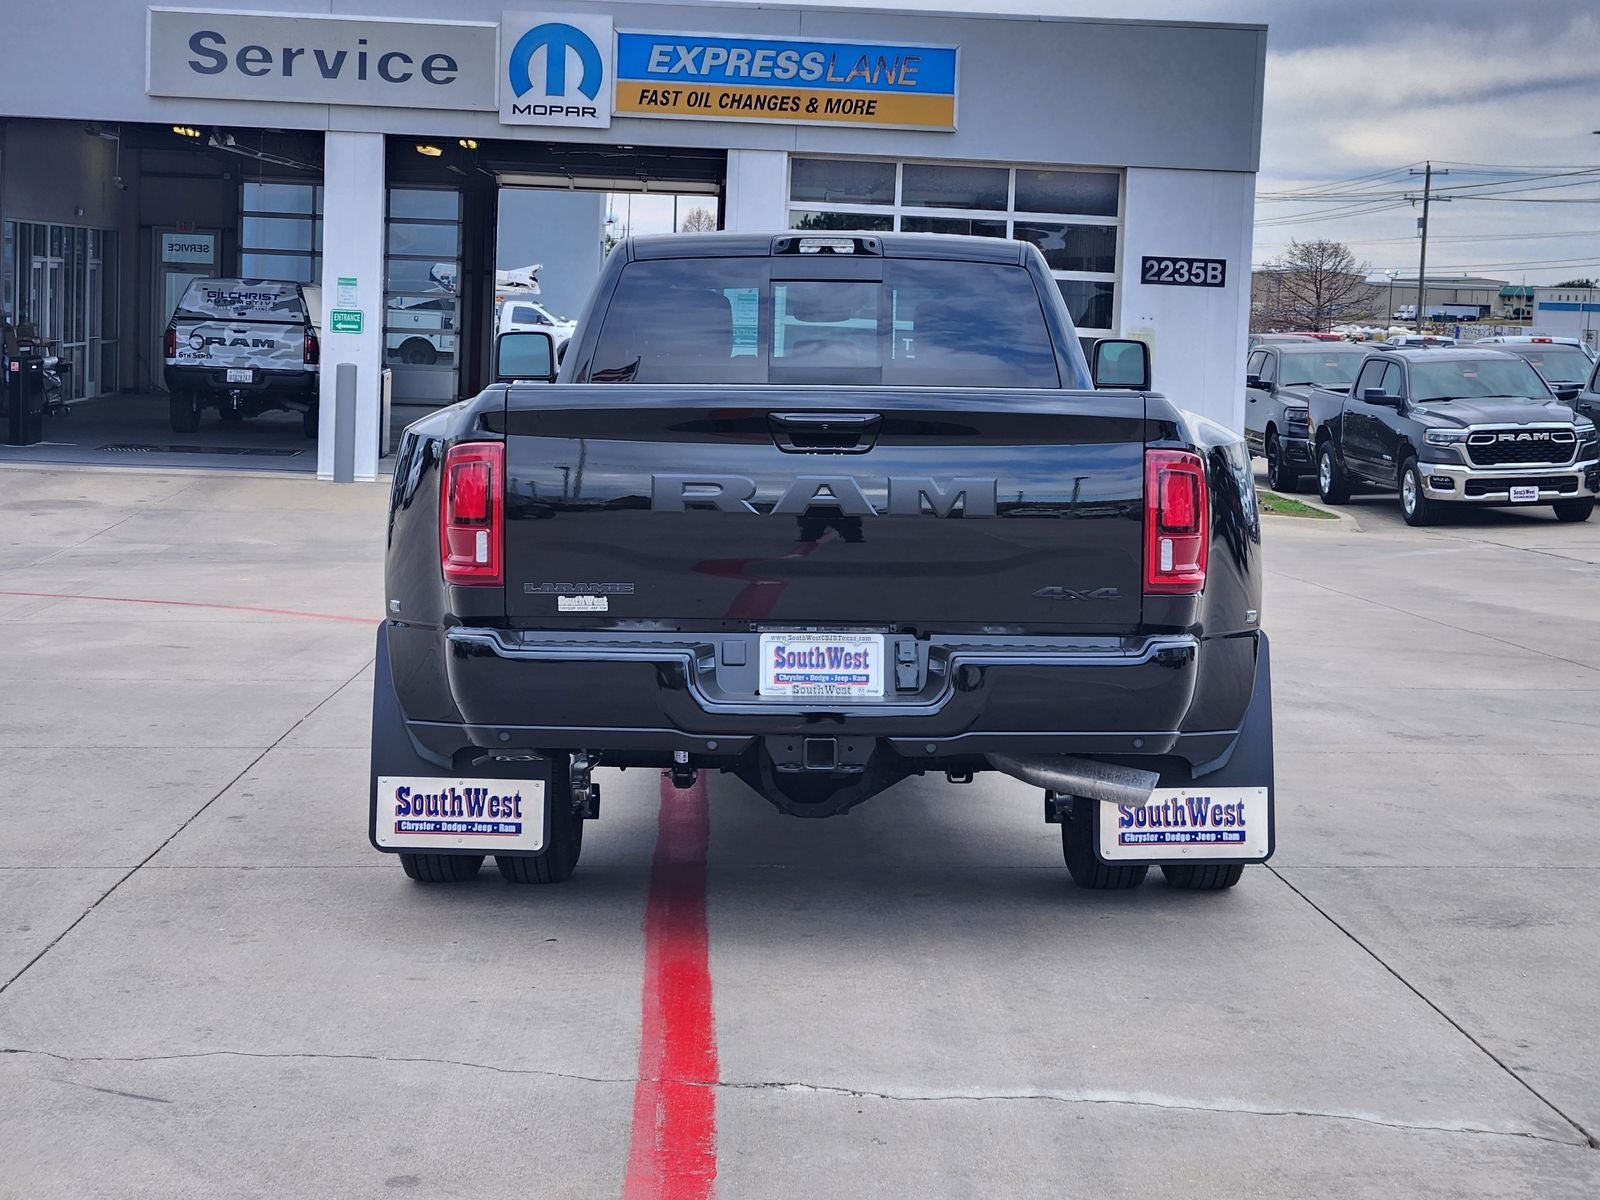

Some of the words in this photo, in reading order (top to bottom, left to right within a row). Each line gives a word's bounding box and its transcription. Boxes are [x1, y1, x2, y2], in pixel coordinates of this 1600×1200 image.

[188, 30, 458, 85] Service
[638, 89, 682, 107] FAST
[686, 91, 712, 108] OIL
[718, 93, 801, 112] CHANGES
[805, 97, 819, 113] &
[824, 98, 877, 115] MORE
[512, 104, 597, 118] MOPAR
[1144, 260, 1223, 284] 2235B
[207, 288, 281, 302] GILCHRIST
[334, 313, 360, 322] ENTRANCE
[205, 336, 275, 349] RAM
[1498, 432, 1549, 441] RAM
[651, 472, 999, 518] RAM
[523, 582, 635, 595] LARAMIE
[773, 645, 870, 670] SouthWest
[778, 675, 805, 683] Chrysler
[810, 675, 830, 683] Dodge
[834, 674, 852, 683] Jeep
[792, 685, 852, 695] SouthWest
[395, 786, 522, 819] SouthWest
[1118, 797, 1246, 829] SouthWest
[401, 821, 435, 832] Chrysler
[441, 822, 467, 833] Dodge
[472, 823, 493, 833] Jeep
[498, 823, 516, 833] Ram
[1124, 833, 1159, 843] Chrysler
[1165, 833, 1191, 843] Dodge
[1196, 831, 1217, 842] Jeep
[1222, 831, 1240, 842] Ram
